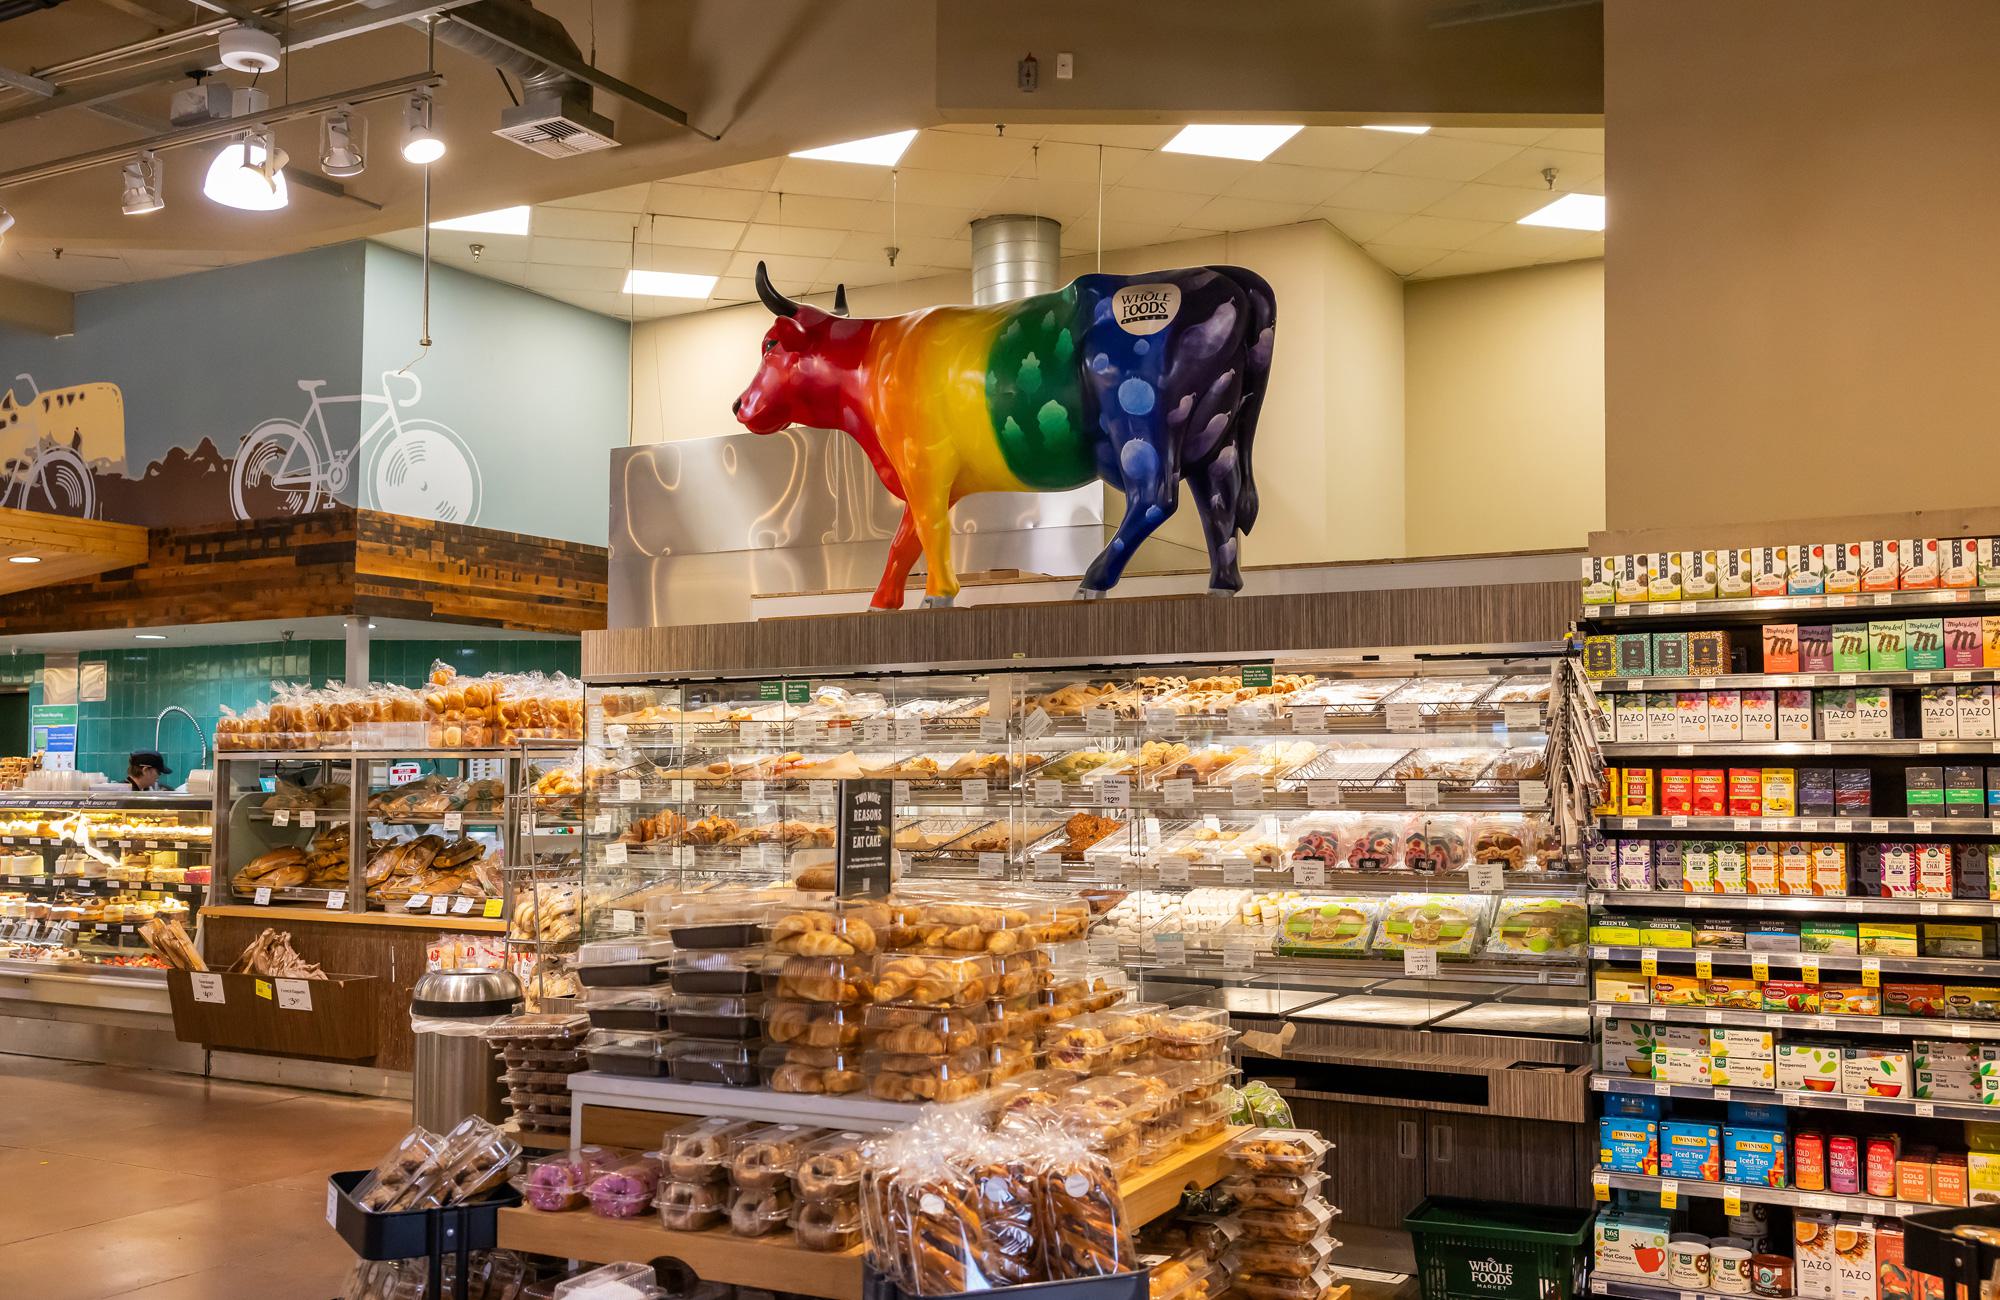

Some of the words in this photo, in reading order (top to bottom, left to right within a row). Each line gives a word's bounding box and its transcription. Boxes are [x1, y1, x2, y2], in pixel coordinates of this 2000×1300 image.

[1121, 292, 1172, 305] WHOLE
[1123, 301, 1168, 318] FOODS
[1828, 710, 1855, 720] TAZO
[1860, 710, 1888, 718] TAZO
[1924, 708, 1954, 717] TAZO
[1960, 708, 1991, 717] TAZO
[1618, 713, 1644, 722] TAZO
[1649, 713, 1675, 722] TAZO
[1680, 715, 1706, 724] TAZO
[1712, 714, 1738, 723] TAZO
[1745, 714, 1772, 723] TAZO
[1781, 714, 1809, 723] TAZO
[855, 792, 867, 805] TWO
[868, 792, 881, 805] MORE
[854, 809, 882, 822] REASONS
[853, 836, 865, 848] EAT
[866, 835, 882, 847] CAKE
[1779, 1062, 1806, 1070] Peppermint
[1675, 1136, 1704, 1144] TWININGS
[1739, 1142, 1769, 1150] TWININGS
[1691, 1152, 1703, 1160] Tea
[1868, 1154, 1881, 1162] COLD
[1756, 1158, 1769, 1166] Tea
[1468, 1257, 1513, 1274] WHOLE
[1801, 1260, 1832, 1271] TAZO
[1472, 1272, 1513, 1286] FOODS
[1840, 1269, 1871, 1281] TAZO
